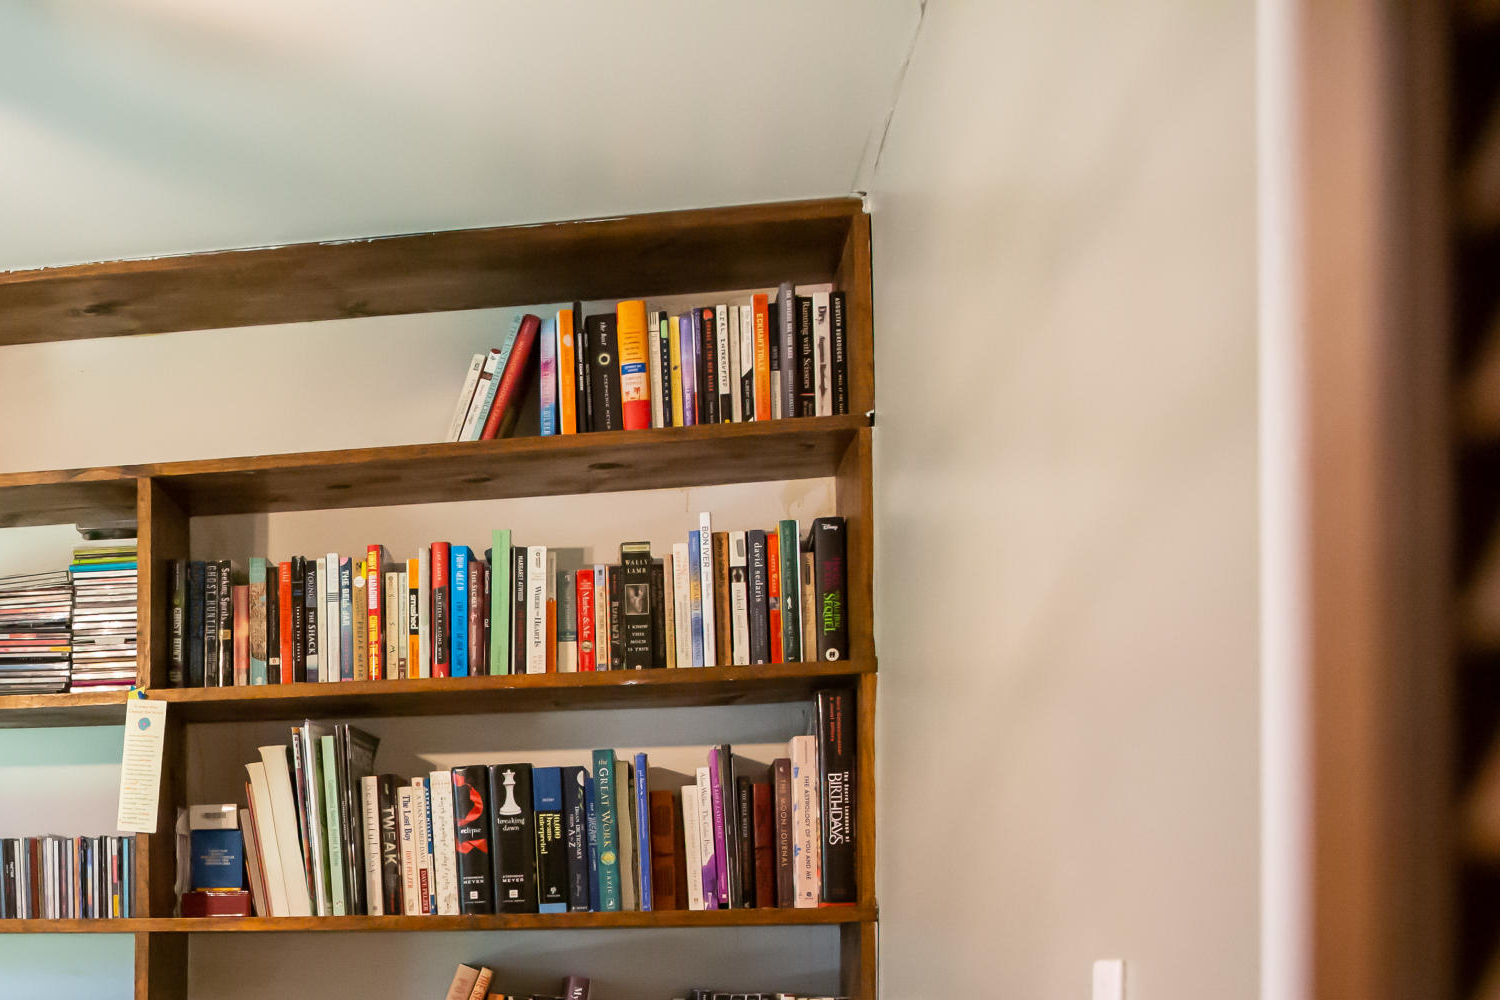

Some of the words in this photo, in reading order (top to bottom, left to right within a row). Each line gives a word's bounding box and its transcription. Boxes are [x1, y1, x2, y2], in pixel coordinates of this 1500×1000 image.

[801, 301, 810, 335] Running
[756, 313, 765, 347] ECKHART
[802, 337, 811, 355] with
[756, 349, 765, 370] TOLLE
[802, 358, 811, 388] Scissors
[455, 554, 465, 568] JOHN
[754, 543, 763, 567] david
[206, 565, 216, 595] GHOST
[341, 570, 349, 586] THE
[455, 571, 465, 591] GREEN
[754, 570, 763, 602] sedaris
[341, 588, 349, 608] BELL
[173, 607, 181, 636] GHOST
[206, 600, 216, 641] HUNTING
[307, 611, 315, 624] THE
[341, 610, 349, 626] JAR
[410, 594, 419, 629] smashed
[823, 593, 836, 633] SEQUEL
[173, 638, 181, 661] HUNT
[307, 624, 315, 654] SHACK
[599, 768, 610, 807] GREAT
[780, 780, 788, 794] THE
[402, 795, 411, 808] The
[780, 798, 788, 825] MOON
[803, 789, 812, 827] ASTROLOGY
[827, 773, 843, 845] BIRTHDAYS
[402, 811, 411, 827] Lost
[497, 817, 525, 827] breaking
[546, 814, 554, 842] Dreams
[553, 814, 561, 839] 10,000
[601, 810, 613, 848] WORK
[382, 806, 397, 865] TWEAK
[402, 828, 411, 842] Boy
[418, 820, 426, 845] NAMED
[461, 827, 481, 838] eclipse
[538, 814, 548, 855] Interpreted
[803, 828, 812, 838] OF
[780, 829, 788, 868] JOURNAL
[803, 840, 812, 853] YOU
[406, 851, 414, 866] DAVE
[803, 854, 812, 869] AND
[406, 867, 414, 889] PELZER
[421, 870, 429, 886] DAVE
[803, 870, 812, 880] ME
[421, 887, 429, 911] PELZER
[479, 974, 489, 985] THE
[571, 986, 582, 1000] My
